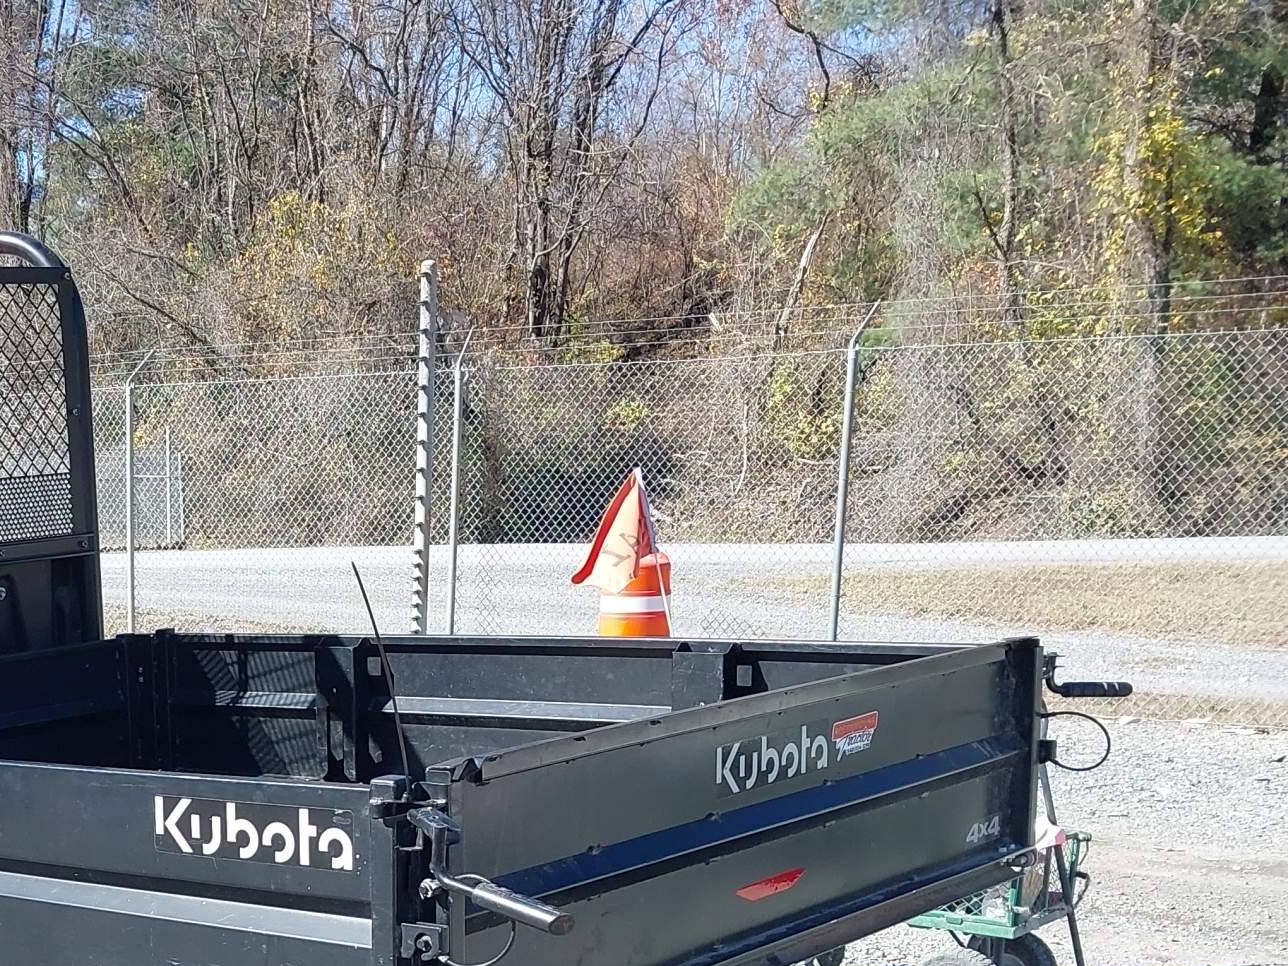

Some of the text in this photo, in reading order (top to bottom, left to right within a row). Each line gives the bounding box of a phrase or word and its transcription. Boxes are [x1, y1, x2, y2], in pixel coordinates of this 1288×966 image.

[715, 725, 828, 794] Kubota
[154, 796, 354, 871] Kubota
[966, 815, 1001, 843] 4x4
